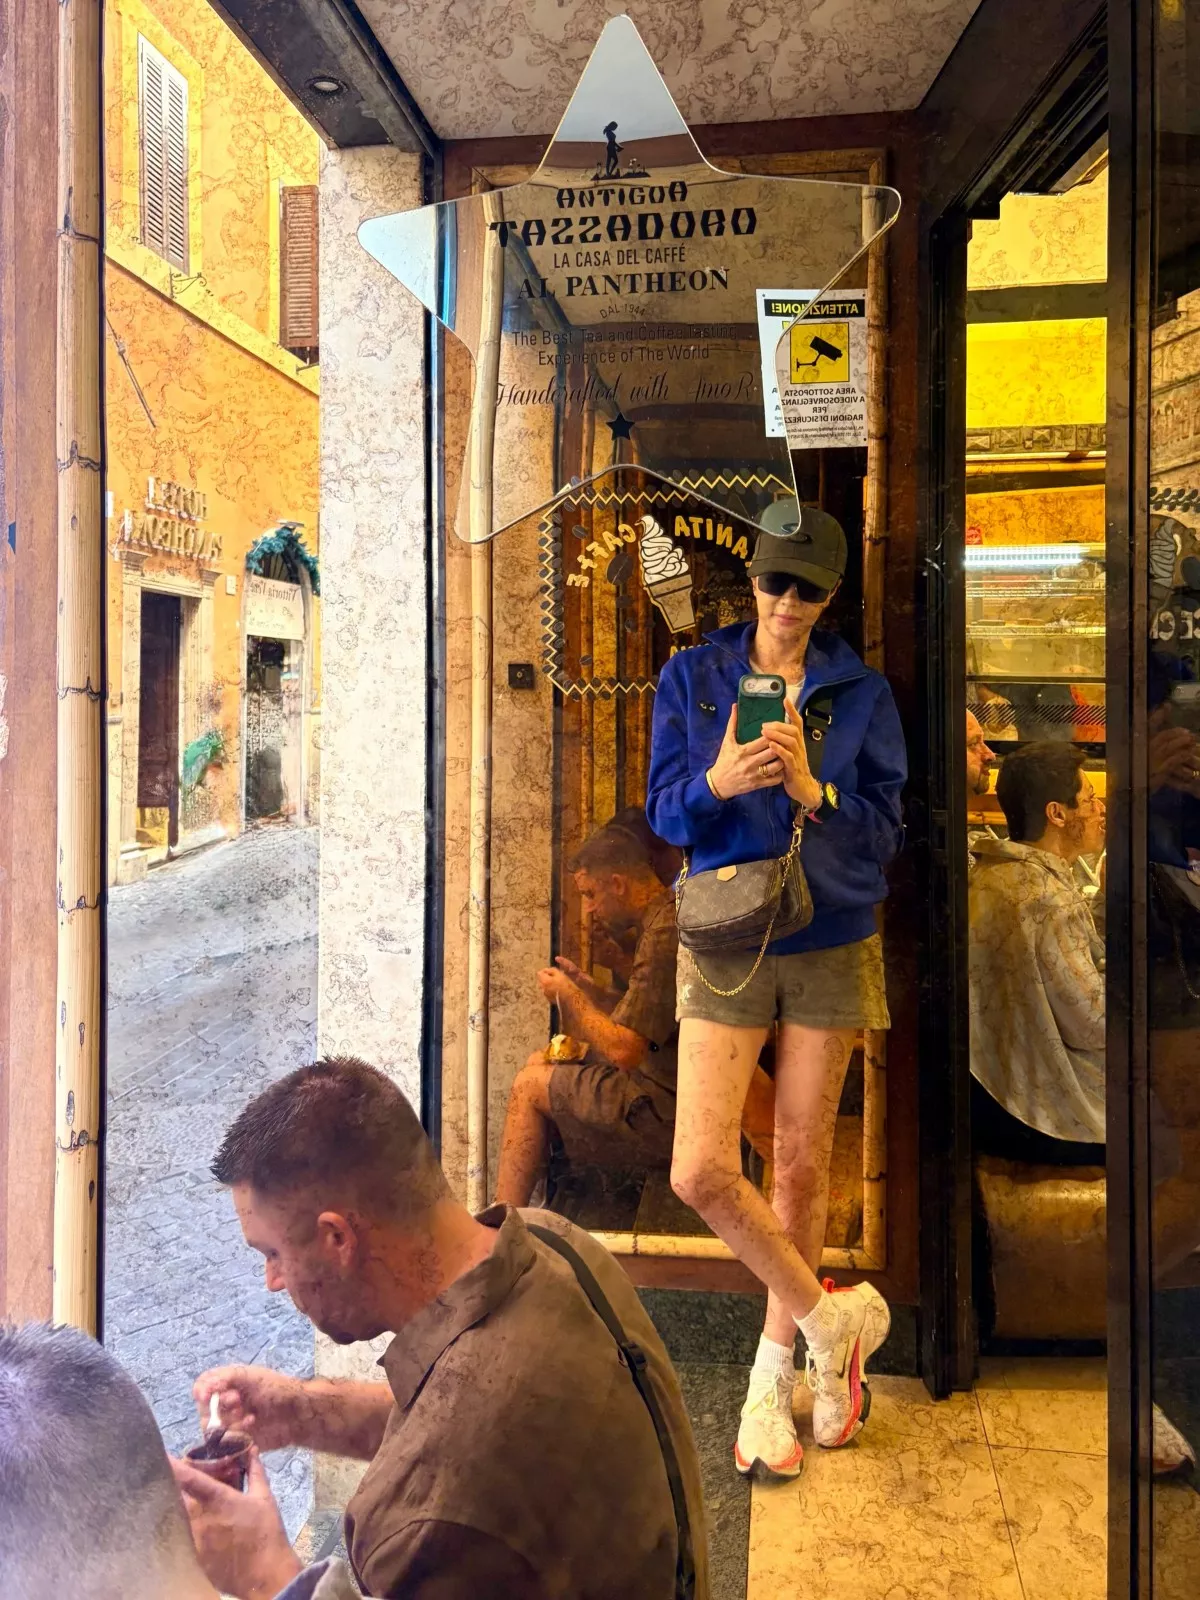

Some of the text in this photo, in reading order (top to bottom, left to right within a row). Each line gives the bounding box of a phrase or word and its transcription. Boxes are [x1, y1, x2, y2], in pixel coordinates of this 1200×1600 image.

[556, 181, 688, 208] ANTIGUA
[489, 207, 757, 248] TAZZADORO
[554, 243, 686, 268] LA CASA DEL CAFFÉ
[518, 268, 730, 300] AL PANTHEON
[600, 304, 645, 318] DAL 1944
[512, 324, 738, 346] The Best Tea and Coffee Tasting
[538, 344, 710, 369] Experience of The World
[495, 372, 623, 415] Handcrafted
[630, 371, 669, 401] with
